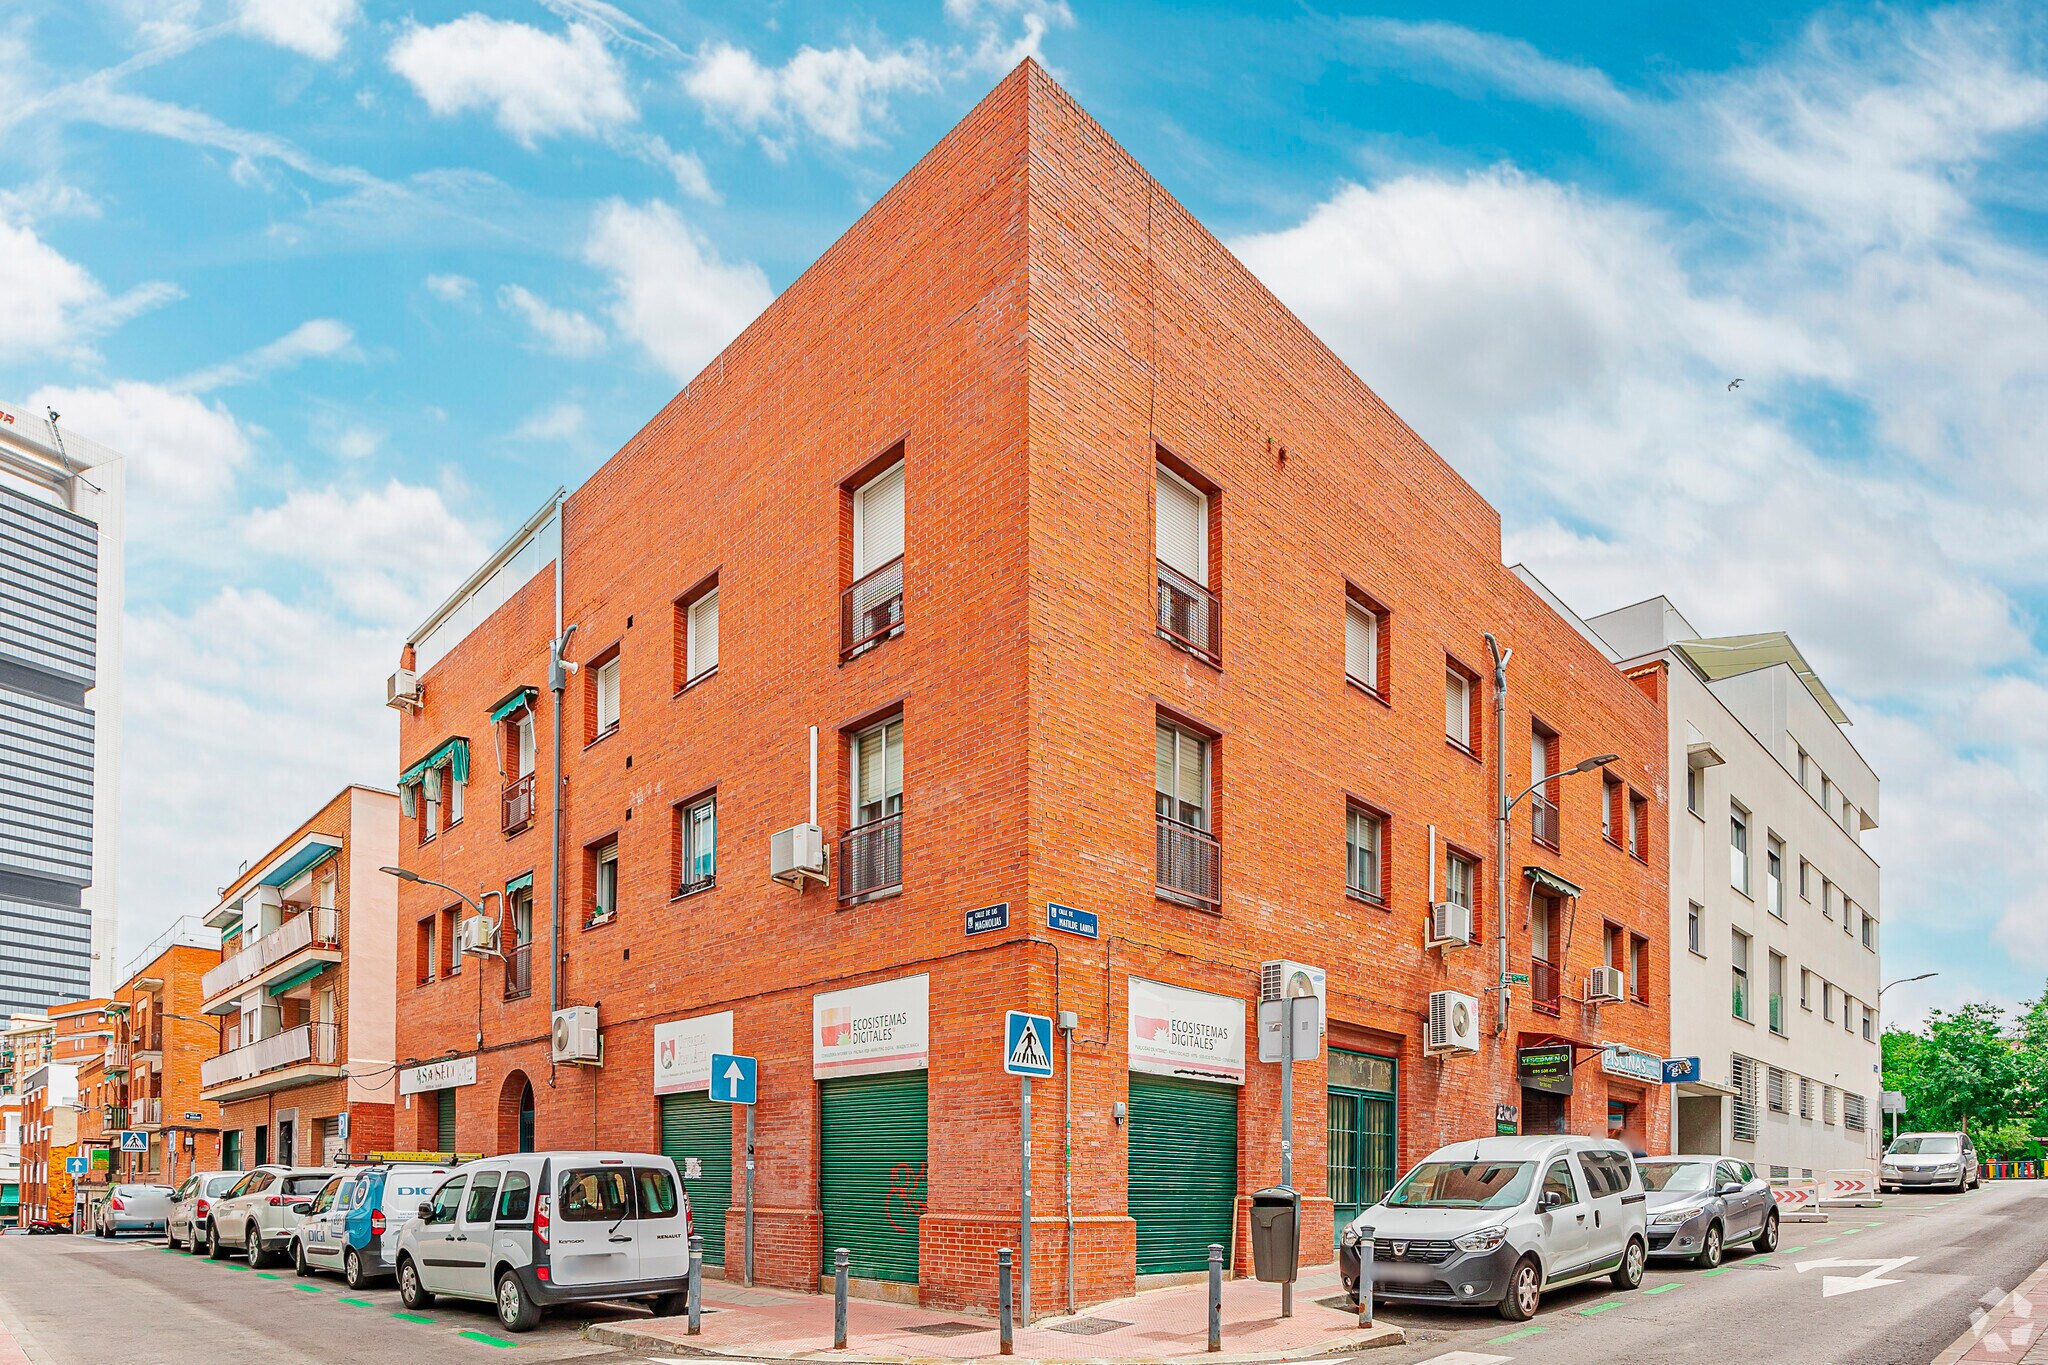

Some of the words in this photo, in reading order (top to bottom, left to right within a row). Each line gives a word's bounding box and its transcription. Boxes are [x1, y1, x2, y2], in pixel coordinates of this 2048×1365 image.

[974, 916, 1002, 930] MAGNOLIAS
[1068, 910, 1074, 918] DE
[1058, 917, 1078, 930] MATILDE
[852, 1012, 907, 1032] ECOSISTEMAS
[1171, 1019, 1228, 1040] ECOSISTEMAS
[852, 1028, 892, 1045] DIGITALES
[1171, 1032, 1214, 1051] DIGITALES
[1604, 1049, 1647, 1075] PISCINAS
